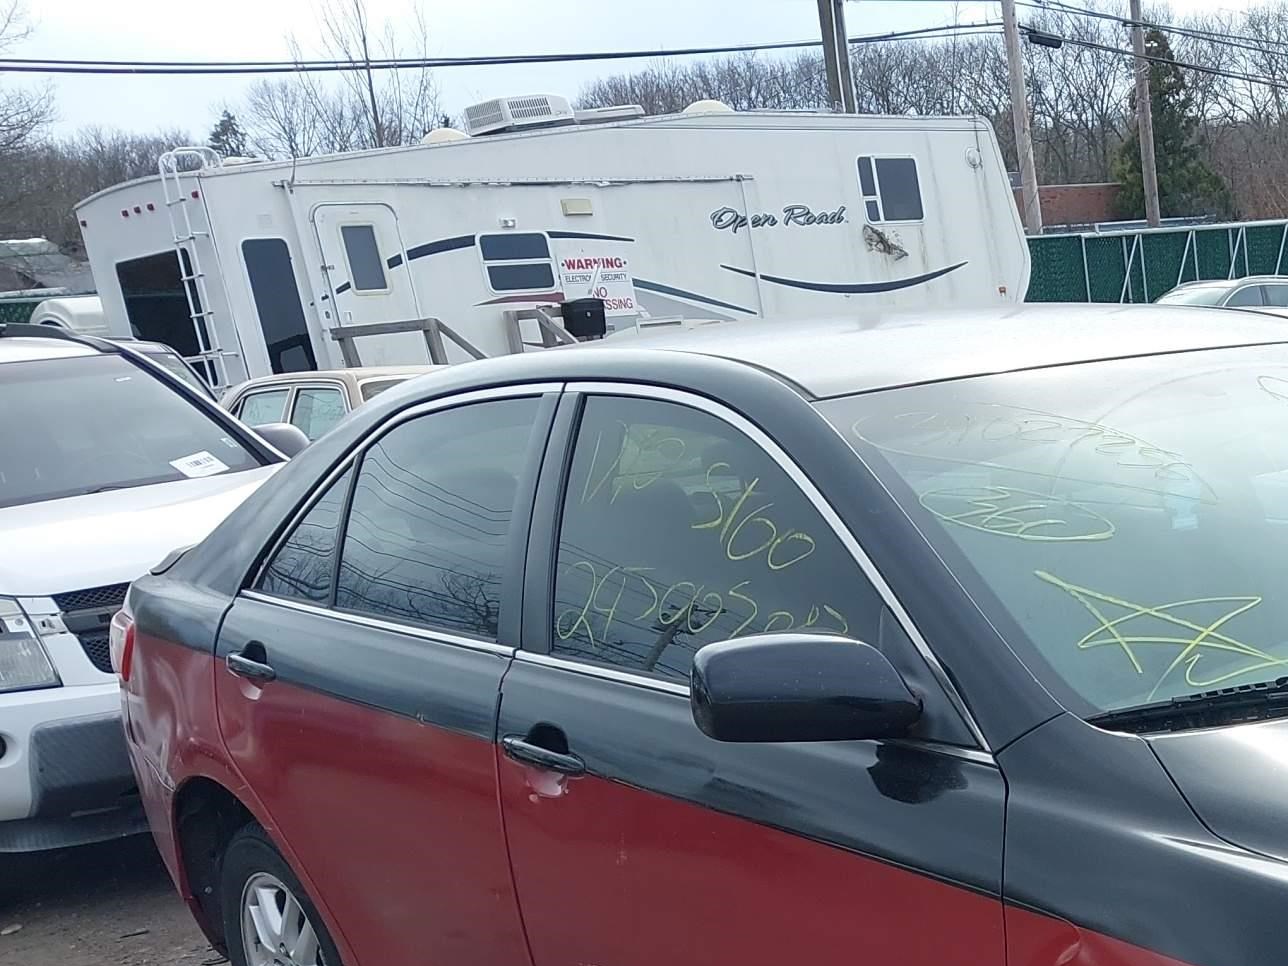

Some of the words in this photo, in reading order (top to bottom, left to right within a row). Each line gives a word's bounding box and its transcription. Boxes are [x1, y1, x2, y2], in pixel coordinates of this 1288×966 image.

[710, 207, 777, 233] Open
[783, 205, 846, 226] Road
[564, 258, 623, 270] WARNING
[604, 298, 633, 311] SSING
